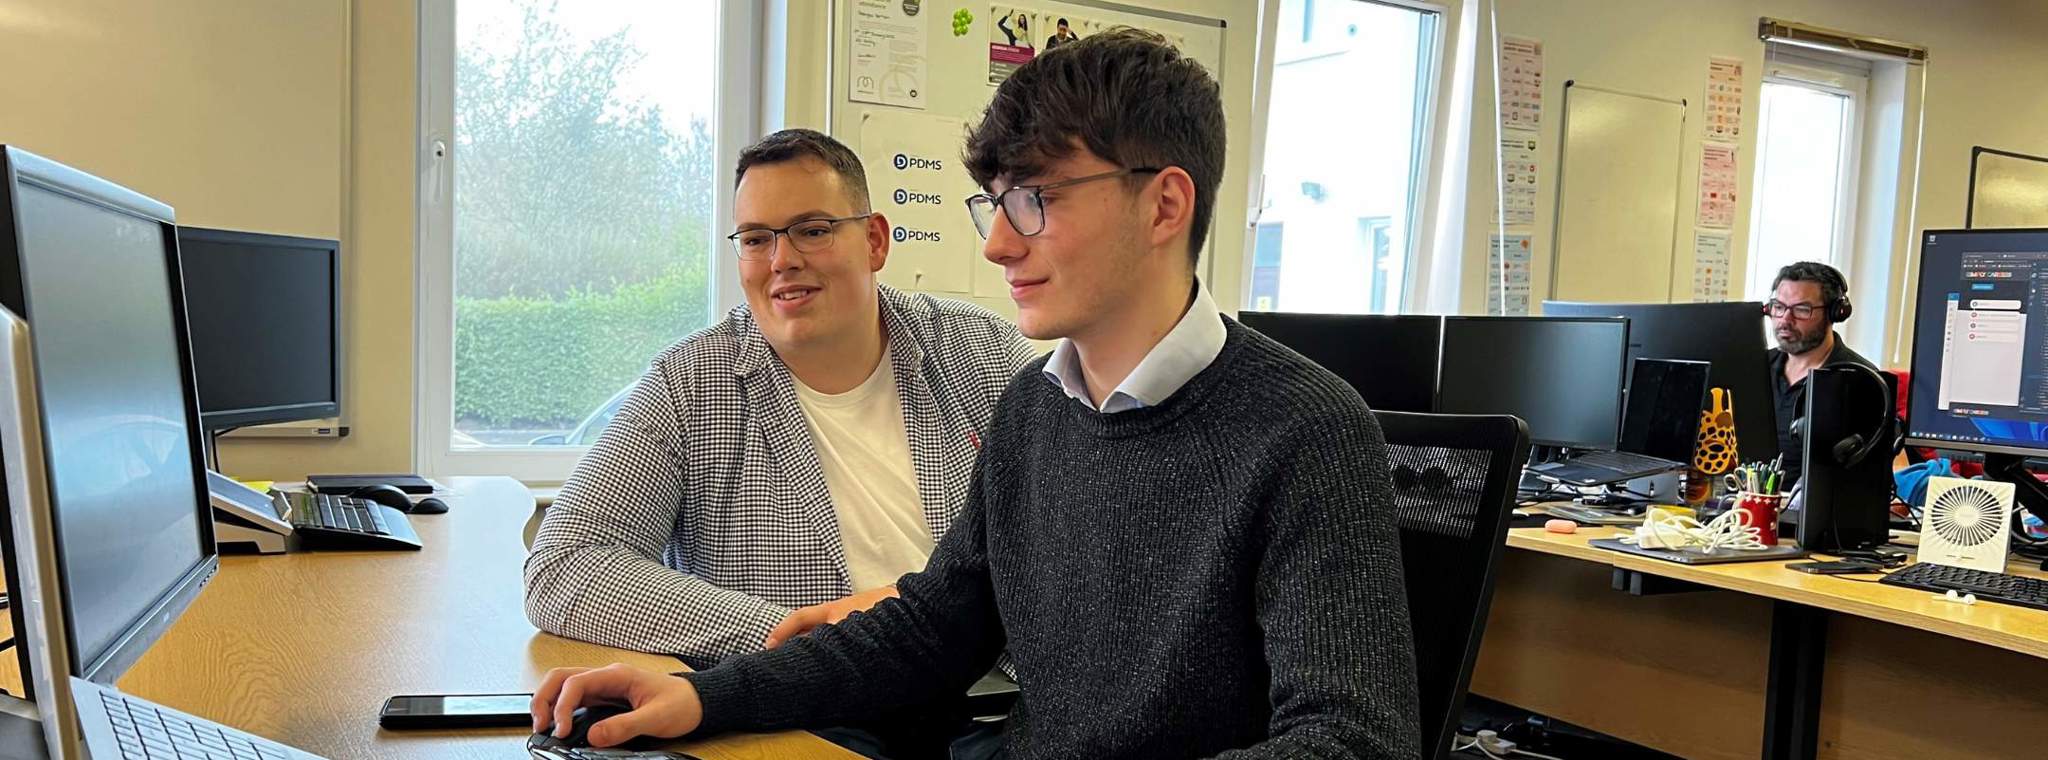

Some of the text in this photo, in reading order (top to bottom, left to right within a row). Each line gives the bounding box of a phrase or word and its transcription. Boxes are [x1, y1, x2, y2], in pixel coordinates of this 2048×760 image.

[909, 158, 942, 170] PDMS
[909, 193, 942, 205] PDMS
[908, 231, 941, 242] PDMS
